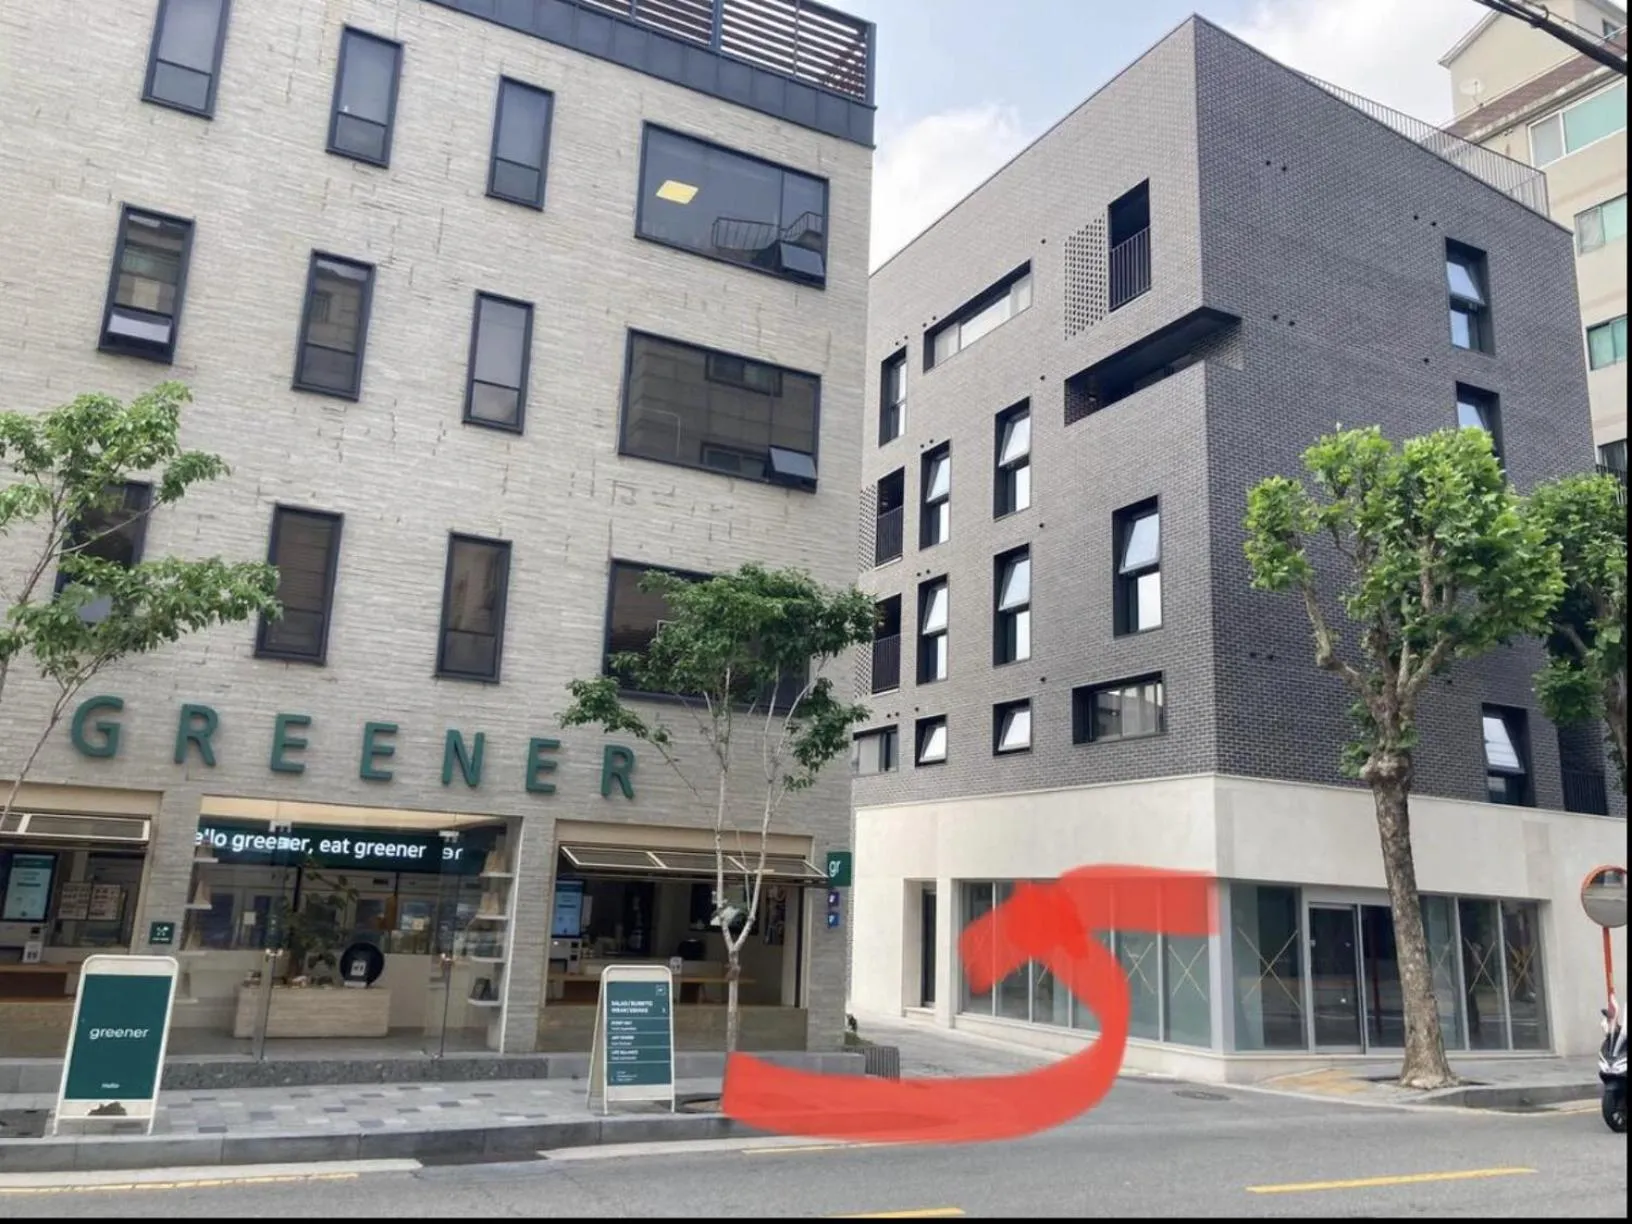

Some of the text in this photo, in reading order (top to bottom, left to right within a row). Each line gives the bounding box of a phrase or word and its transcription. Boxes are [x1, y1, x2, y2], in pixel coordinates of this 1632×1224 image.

[70, 695, 635, 800] GREENER
[320, 838, 350, 854] eat
[354, 841, 427, 859] greener
[829, 860, 841, 877] gr
[89, 1028, 149, 1040] greener
